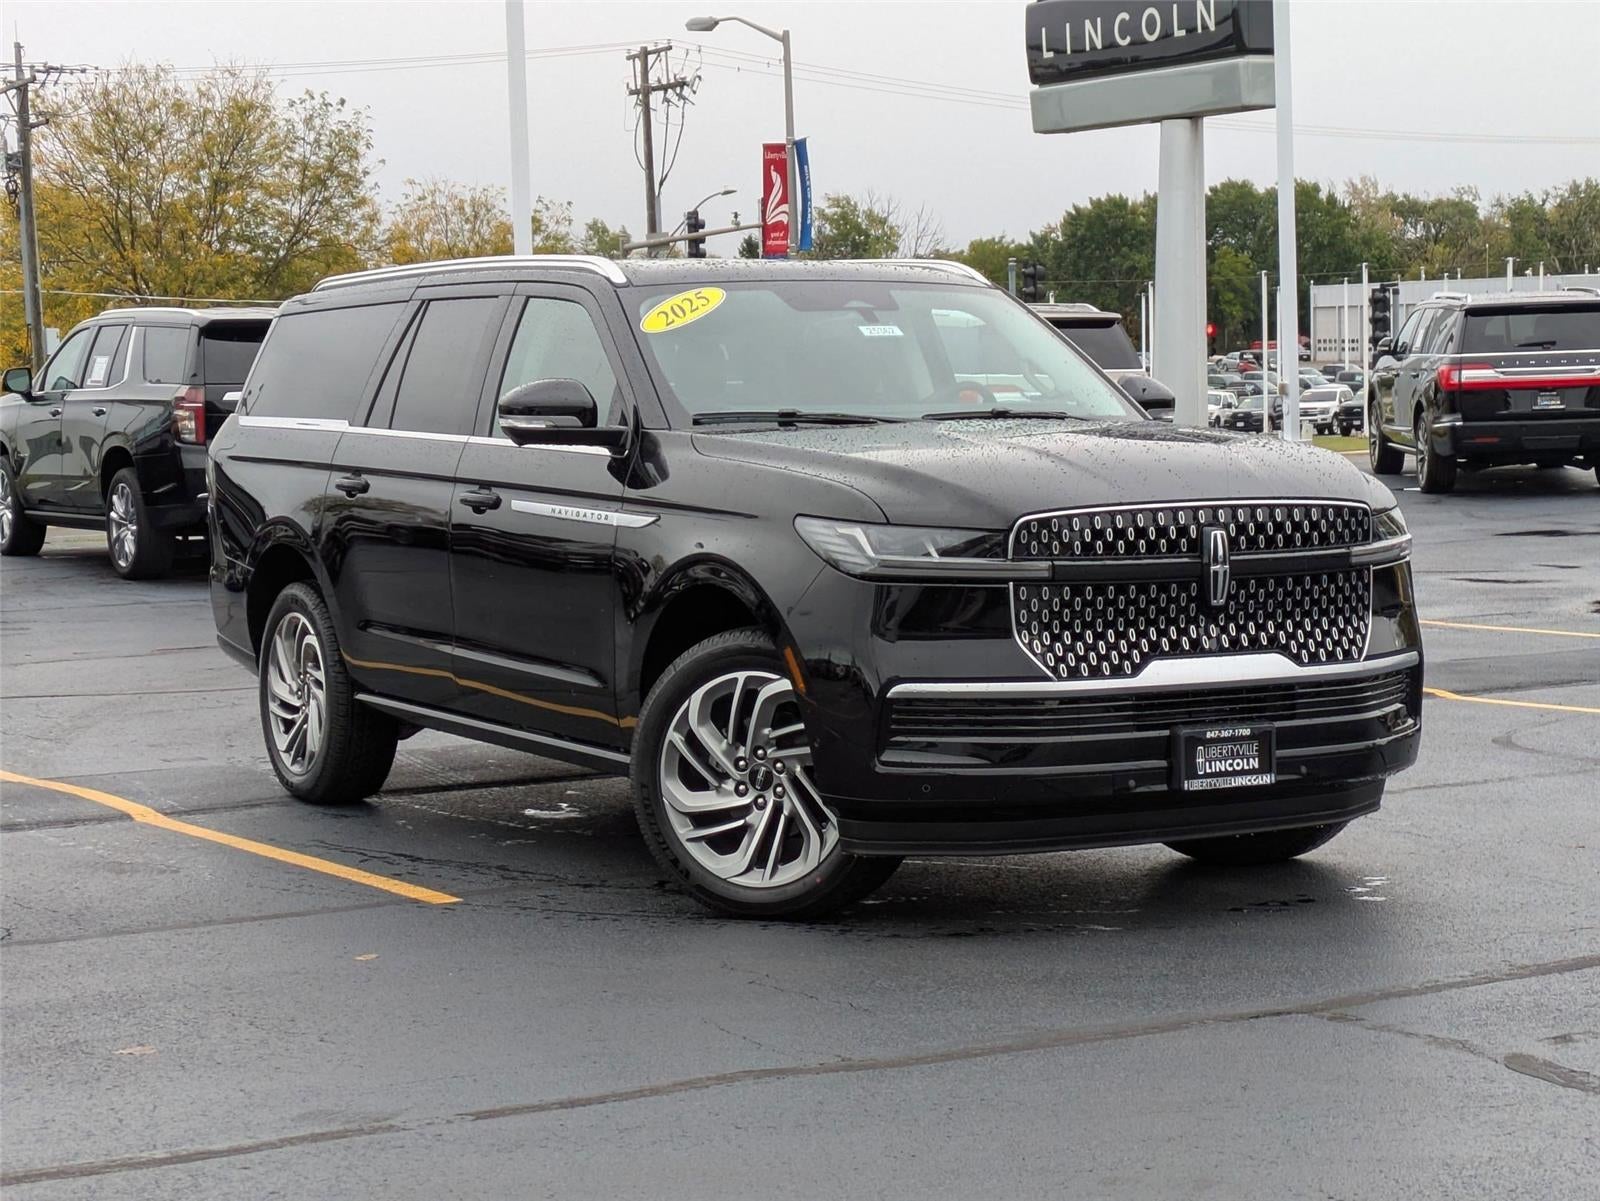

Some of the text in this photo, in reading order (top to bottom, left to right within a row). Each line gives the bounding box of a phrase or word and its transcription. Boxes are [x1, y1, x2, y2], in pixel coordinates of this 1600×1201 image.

[1041, 0, 1216, 58] LINCOLN
[656, 291, 710, 327] 2025
[550, 507, 610, 521] NAVIGATOR
[1206, 728, 1251, 738] 847-367-1700
[1205, 743, 1259, 759] LIBERTYVILLE
[1205, 757, 1259, 773] LINCOLN
